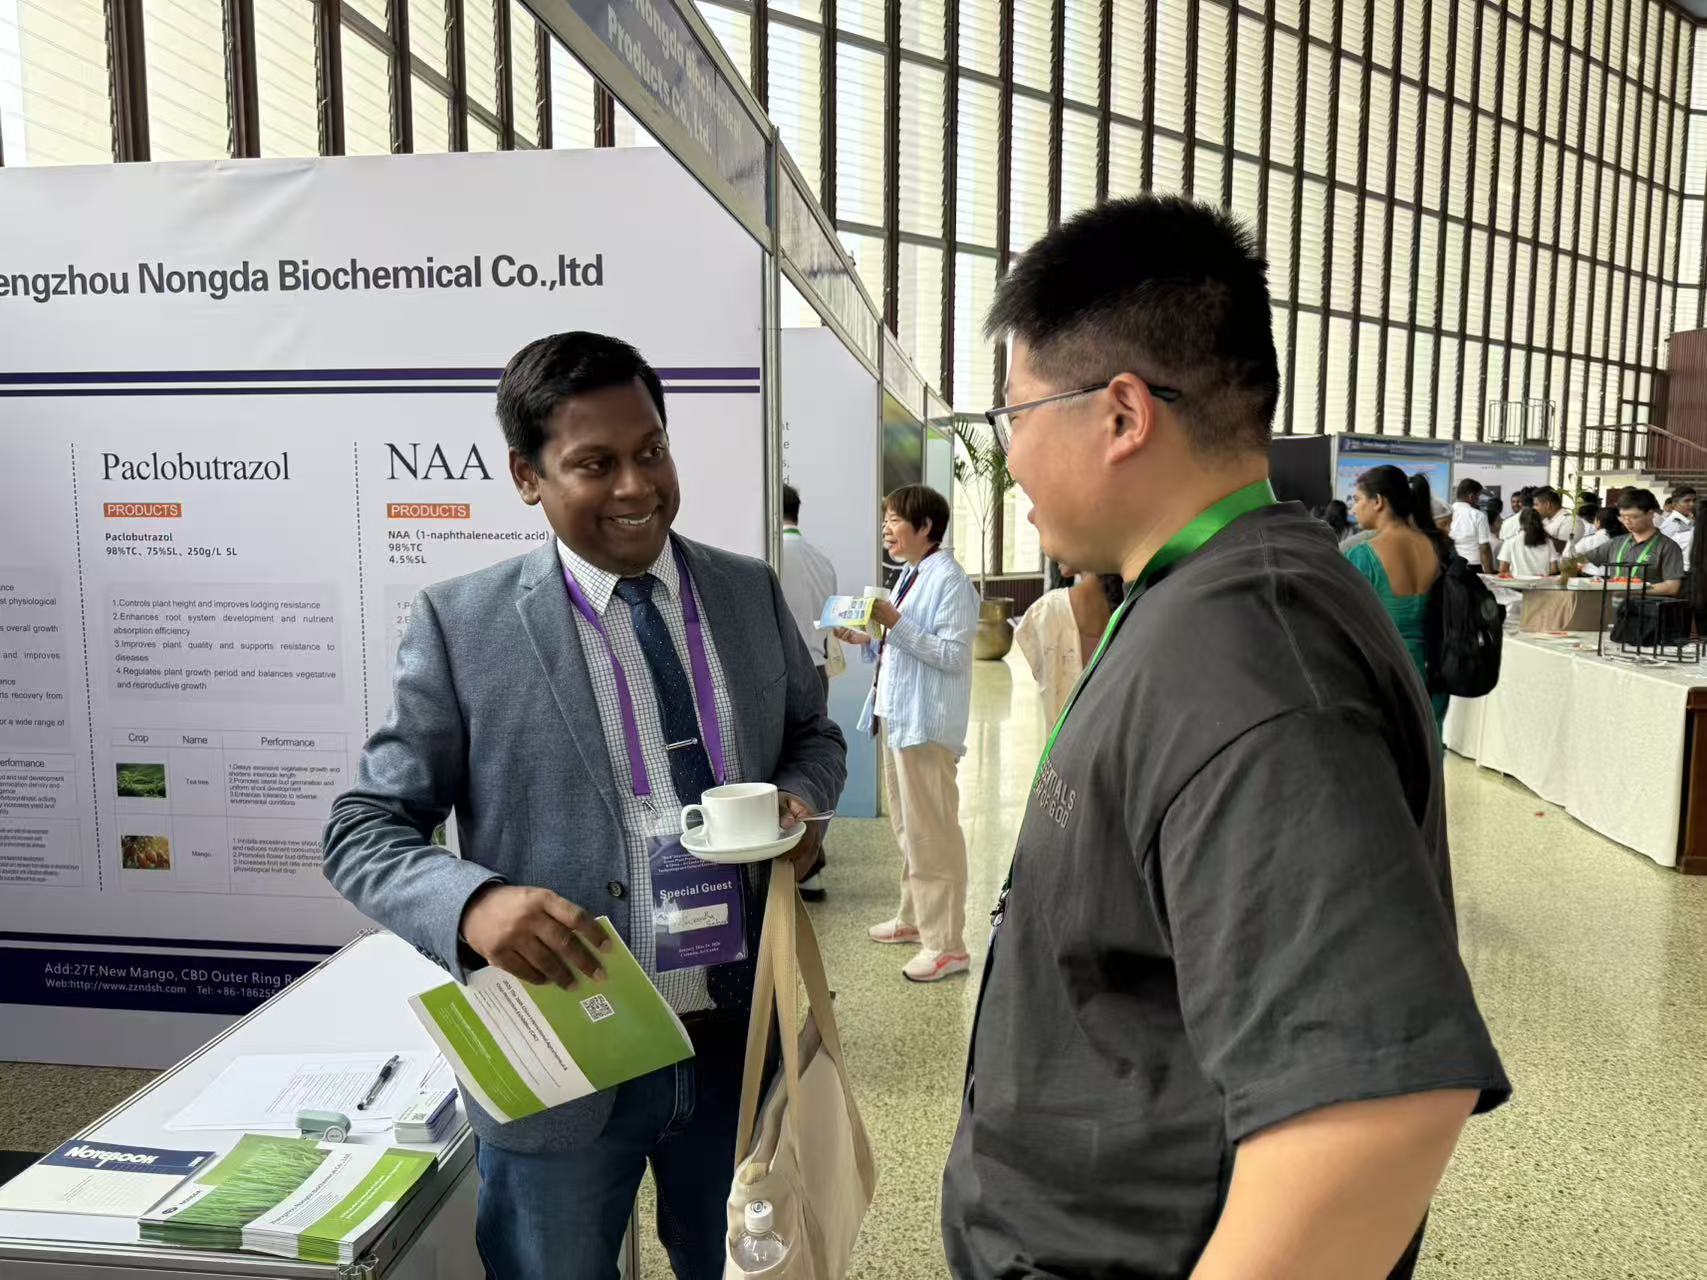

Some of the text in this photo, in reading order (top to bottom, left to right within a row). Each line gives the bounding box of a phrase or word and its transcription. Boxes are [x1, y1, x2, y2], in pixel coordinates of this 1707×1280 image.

[608, 3, 670, 106] Products
[138, 261, 269, 300] Nongda
[278, 256, 482, 292] Biochemical
[491, 254, 604, 291] Co.,ltd
[101, 452, 291, 481] Paclobutrazol
[384, 442, 494, 481] NAA
[106, 504, 178, 516] PRODUCTS
[391, 505, 467, 517] PRODUCTS
[105, 532, 173, 542] Paclobutrazol
[388, 531, 410, 539] NAA
[524, 530, 550, 541] acid)
[388, 543, 423, 551] 98%TC
[388, 555, 427, 564] 4.5%SL
[8, 597, 57, 606] physiological
[112, 599, 320, 610] 1.Controls plant height and improves lodging resistance
[112, 612, 334, 623] 2.Enhances root system development and nutrient
[6, 624, 31, 632] overall
[33, 625, 59, 633] growth
[113, 627, 191, 636] absorption efficiency
[162, 641, 182, 649] plant
[187, 641, 213, 650] quality
[240, 643, 274, 651] supports
[280, 643, 320, 651] resistance
[327, 643, 335, 651] to
[24, 651, 60, 660] improves
[164, 668, 183, 676] plant
[185, 668, 211, 677] growth
[214, 669, 238, 678] period
[241, 669, 256, 677] and
[258, 669, 293, 678] balances
[296, 671, 336, 680] vegetative
[132, 681, 179, 690] reproductive
[181, 682, 207, 691] growth
[11, 692, 43, 701] recovery
[128, 733, 315, 747] Crop Name Performance
[1049, 800, 1069, 829] GOD
[659, 880, 733, 901] Special Guest
[130, 966, 178, 982] Mango,
[181, 969, 208, 981] CBD
[211, 970, 248, 983] Outer
[251, 972, 281, 988] Ring
